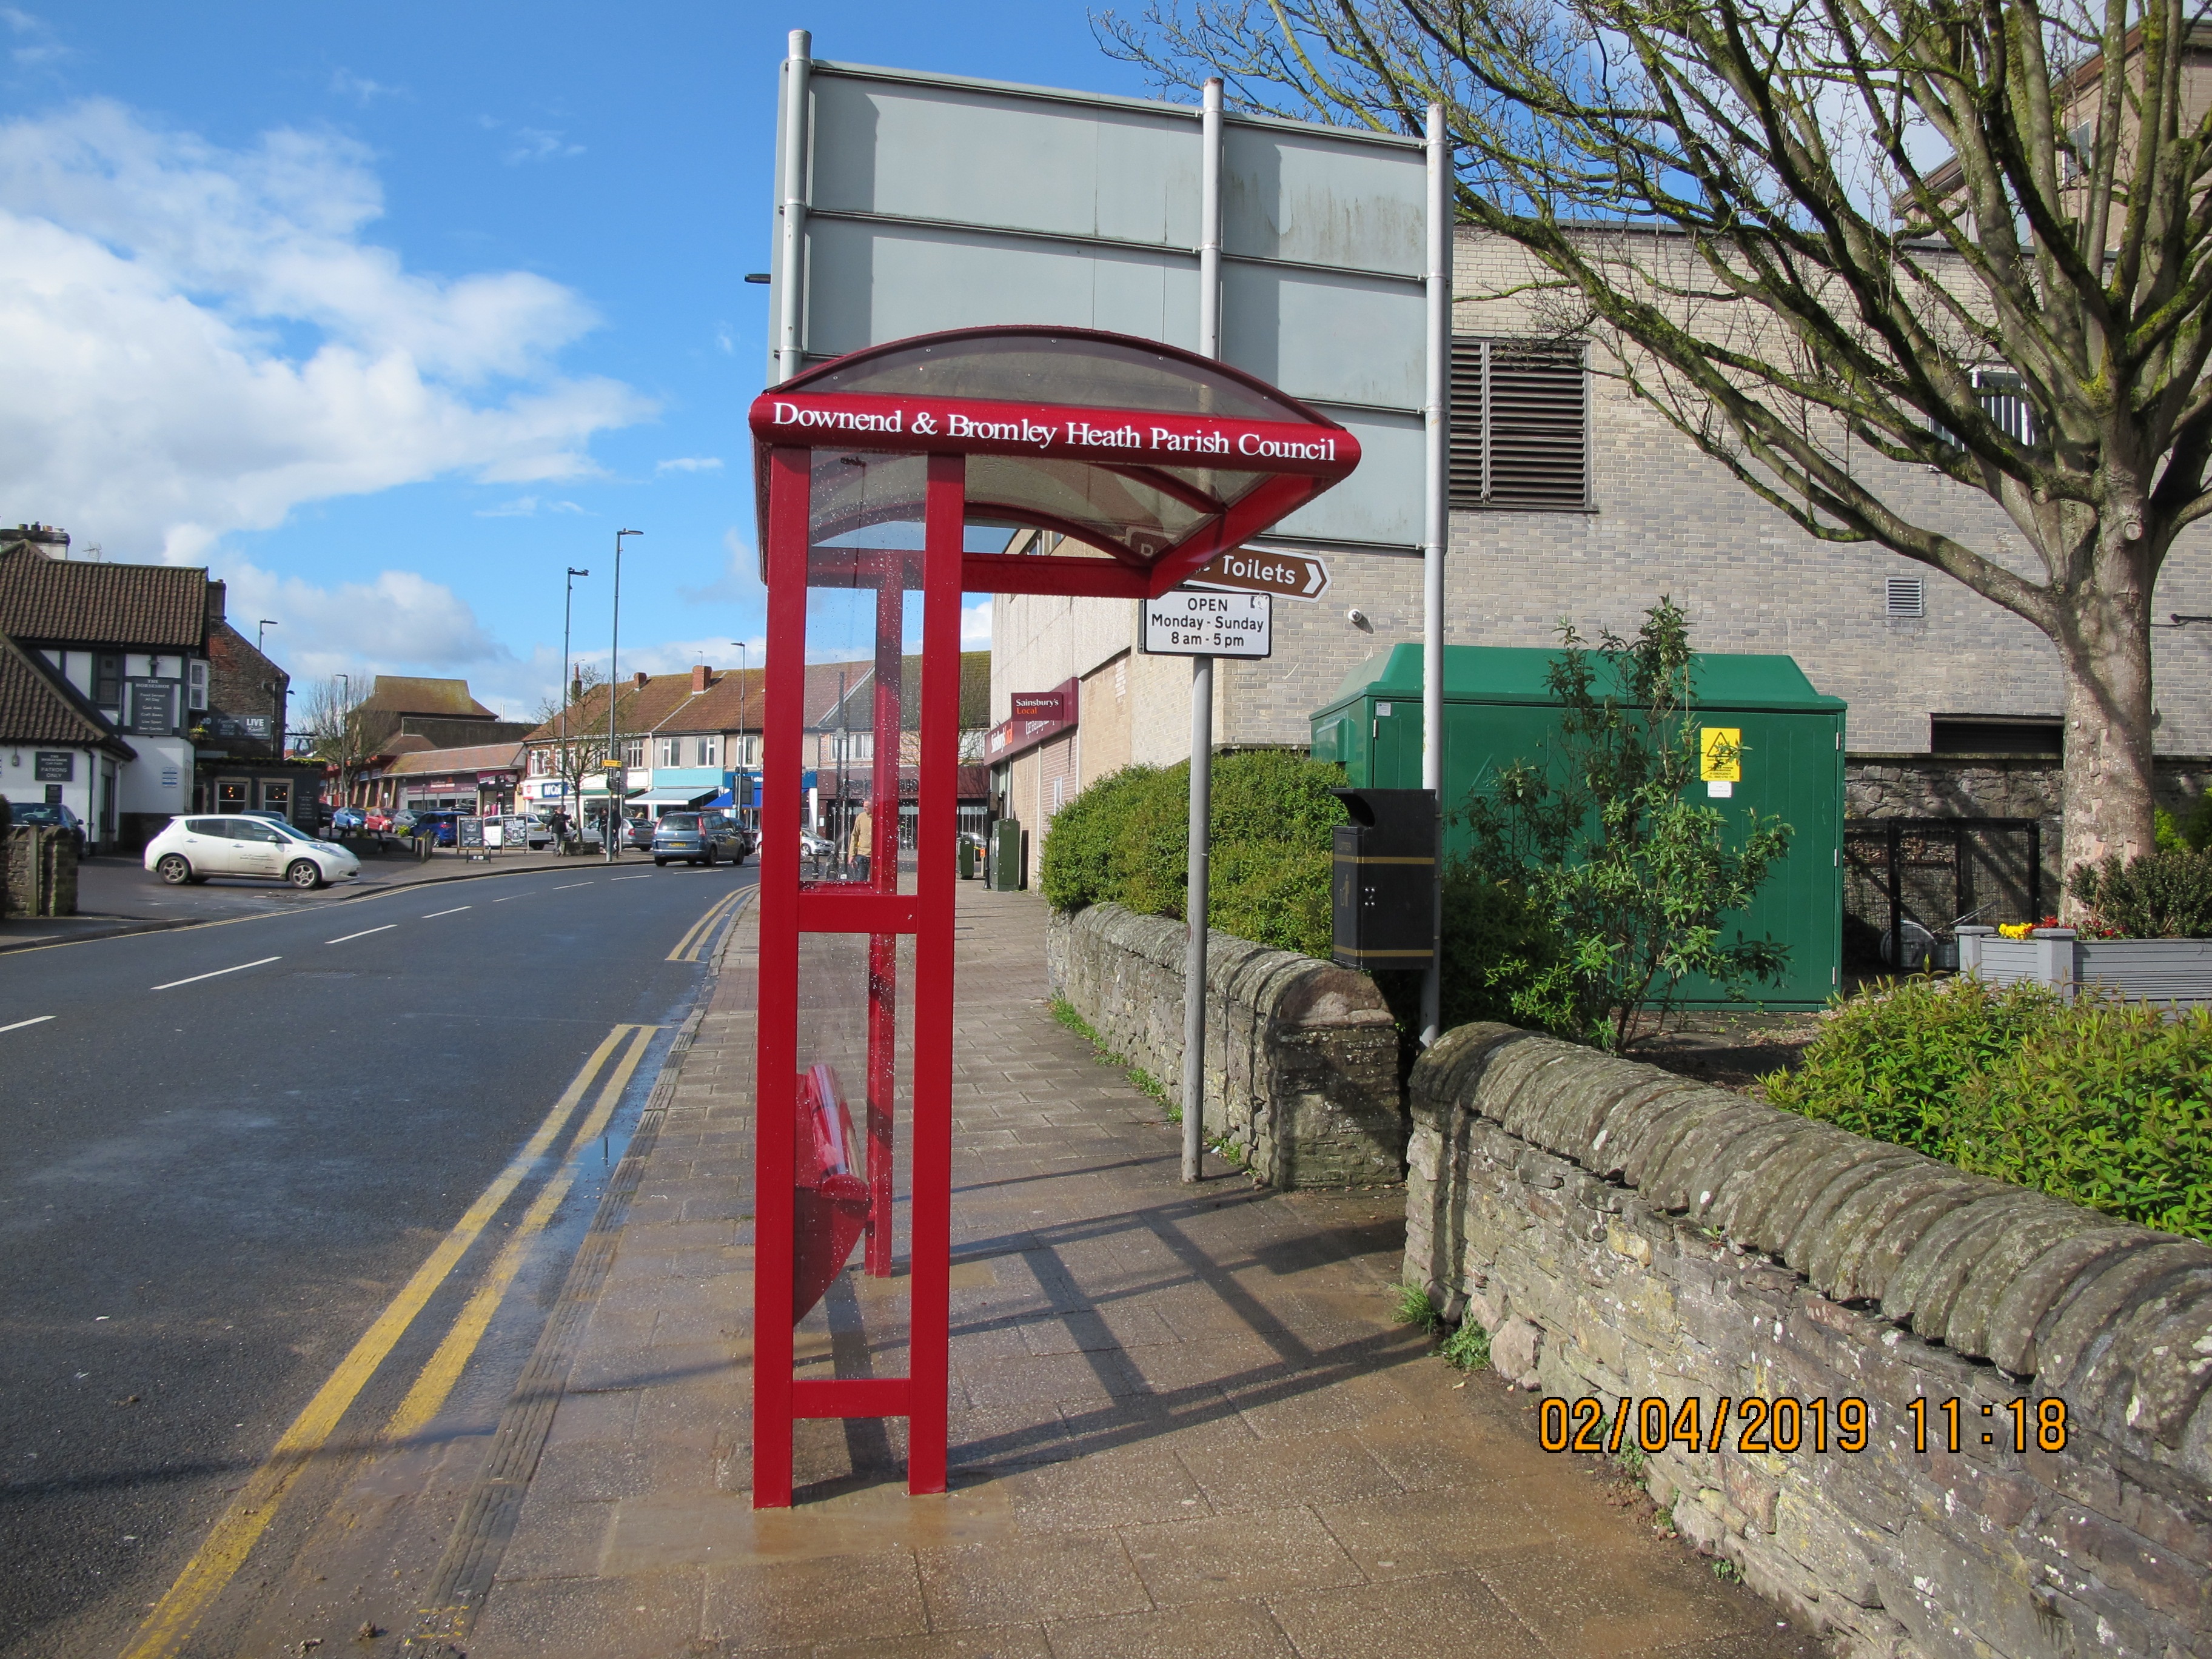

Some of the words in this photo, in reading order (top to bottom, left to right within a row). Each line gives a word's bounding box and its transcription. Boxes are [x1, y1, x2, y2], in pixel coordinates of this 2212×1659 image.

[772, 402, 903, 434] Downend
[910, 412, 938, 435] &
[947, 414, 1057, 449] Bromley
[1065, 422, 1142, 449] Heath
[1148, 427, 1230, 455] Parish
[1238, 433, 1336, 461] Council
[1222, 555, 1296, 585] Toilets
[1187, 597, 1228, 612] OPEN
[1151, 614, 1204, 631] Monday
[1215, 615, 1264, 633] Sunday
[1171, 632, 1179, 645] 8
[1182, 635, 1202, 645] am
[1213, 633, 1221, 646] 5
[1224, 636, 1244, 648] pm
[1016, 699, 1059, 708] Sainsbury's
[246, 718, 264, 726] LIVE
